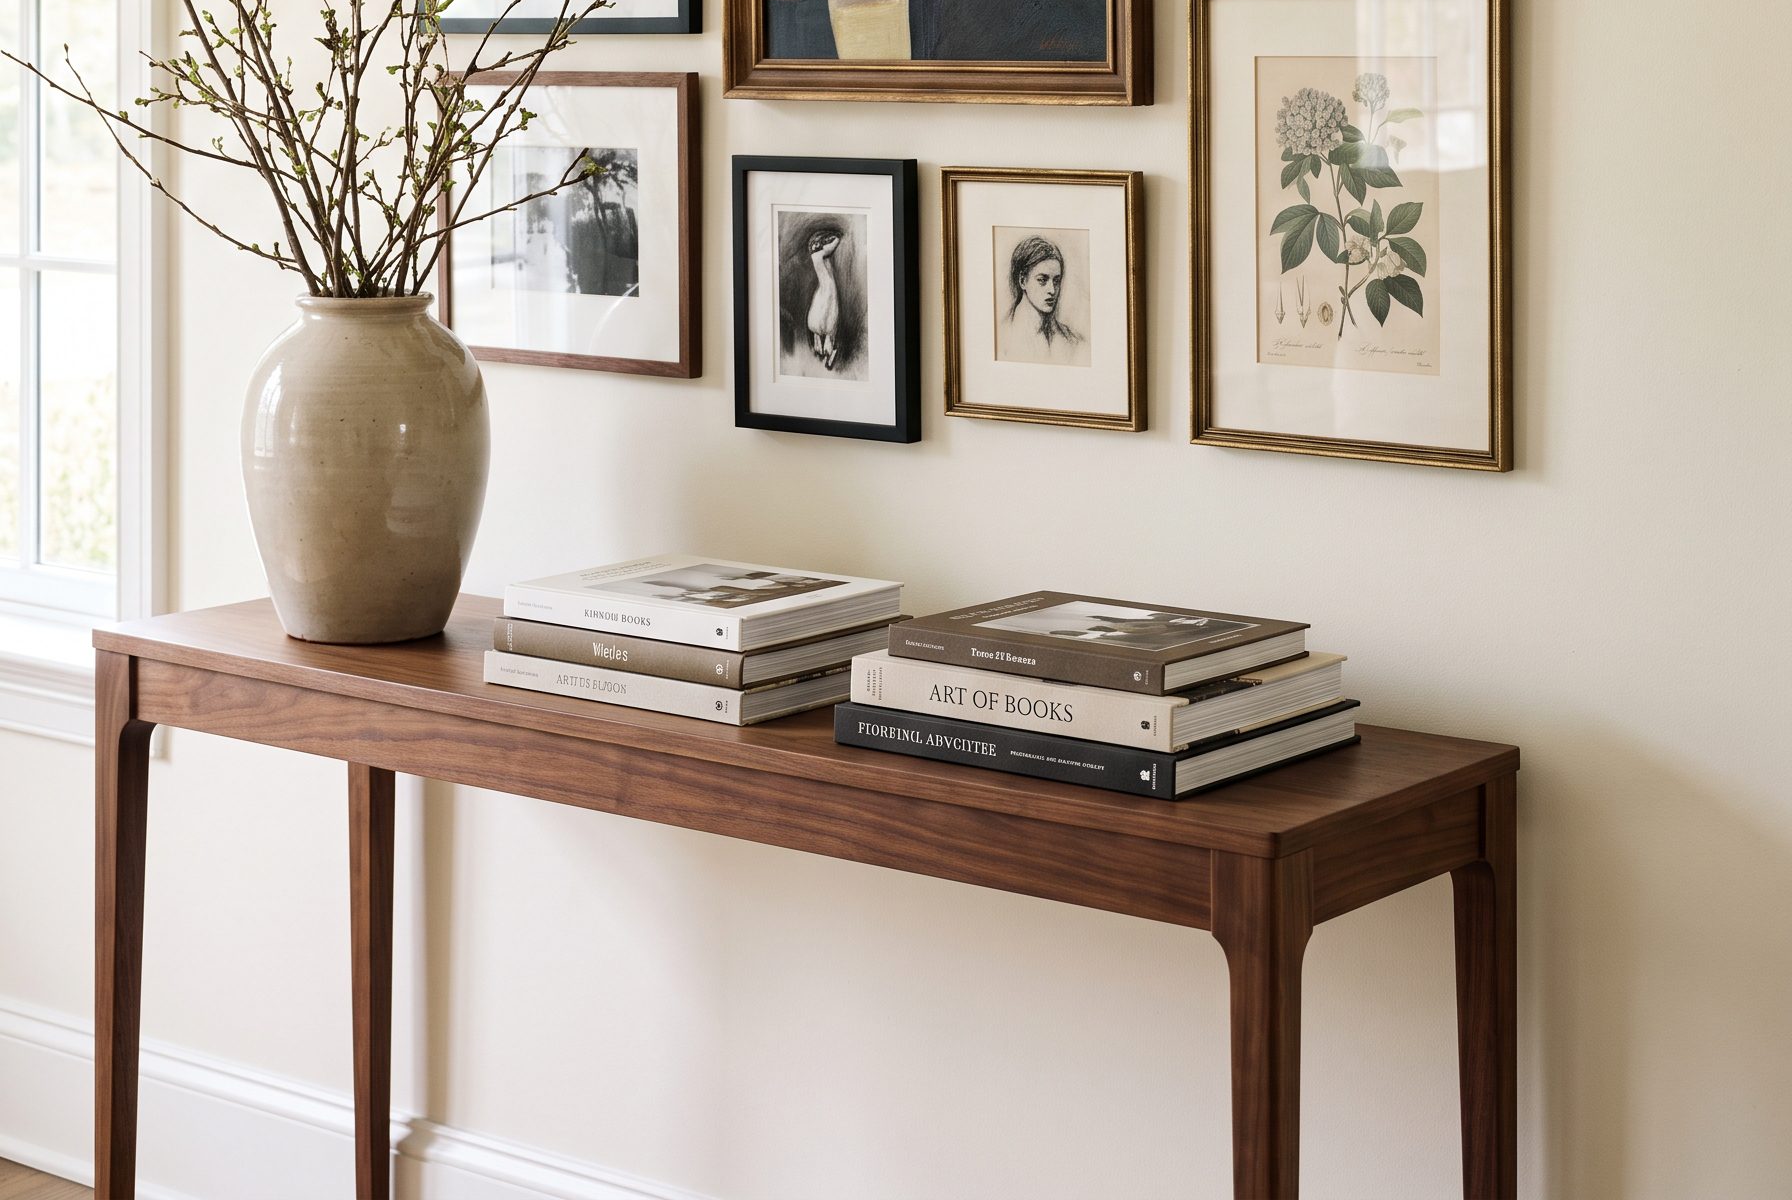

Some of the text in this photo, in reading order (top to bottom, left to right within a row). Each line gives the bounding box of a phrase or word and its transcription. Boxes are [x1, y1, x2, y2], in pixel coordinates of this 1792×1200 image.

[621, 614, 651, 627] BOOKS
[929, 684, 1073, 723] ART OF BOOKS
